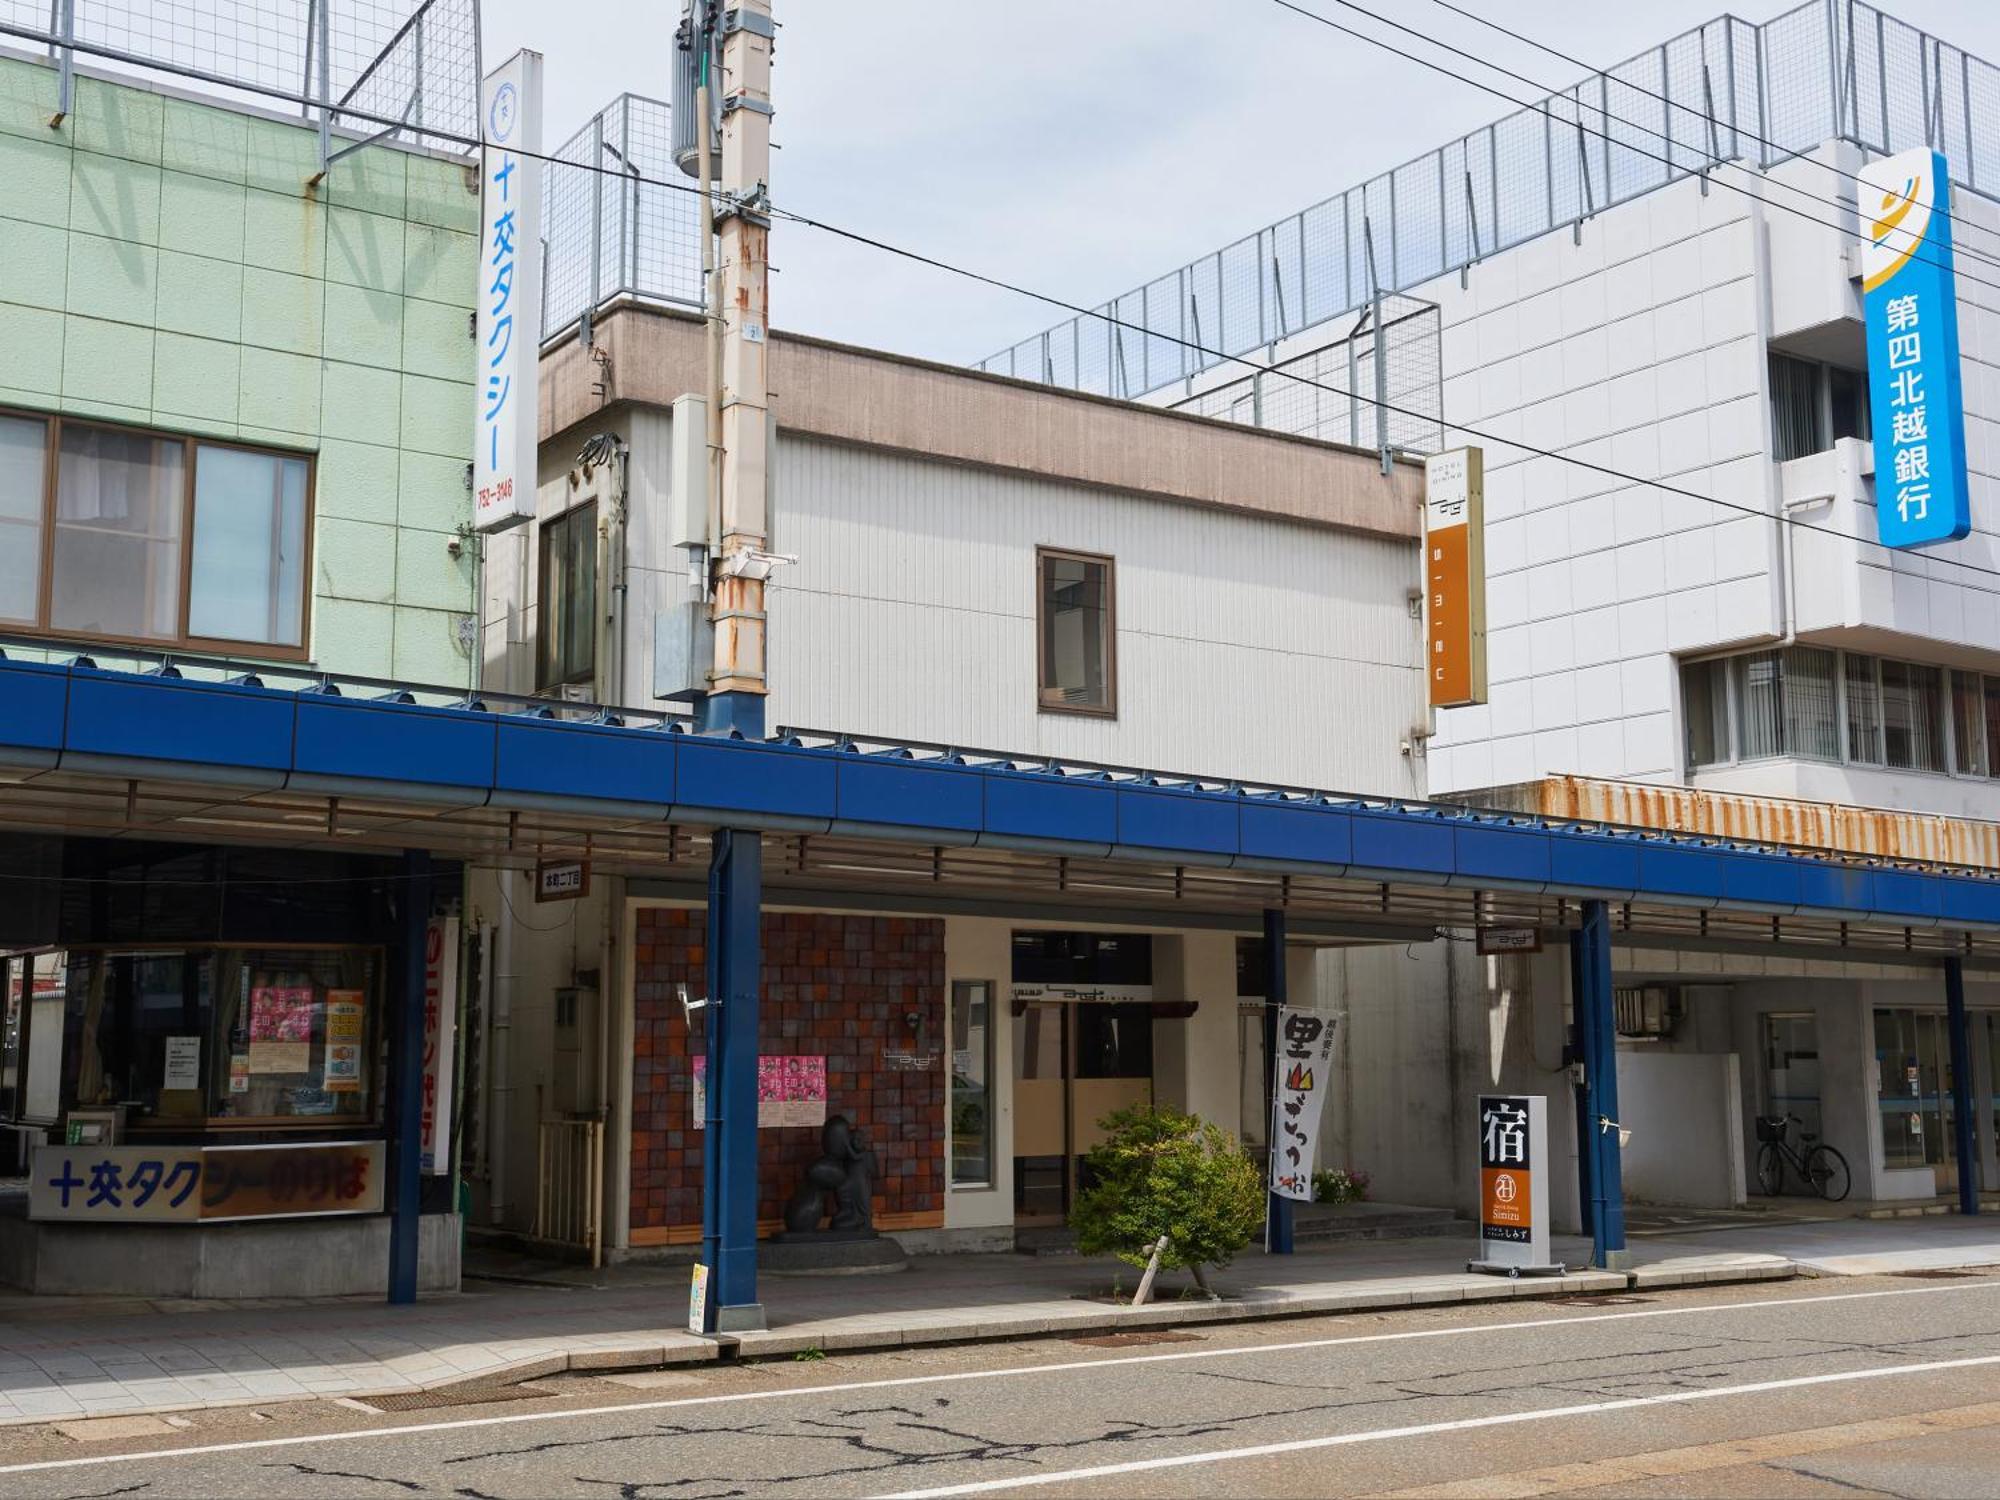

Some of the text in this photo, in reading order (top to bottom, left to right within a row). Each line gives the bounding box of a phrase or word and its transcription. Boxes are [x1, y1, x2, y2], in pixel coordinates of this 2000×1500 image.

[486, 152, 515, 471] 十交タクシー
[1886, 294, 1931, 523] 第四北越銀行
[546, 870, 580, 888] 本町二丁目
[1483, 1103, 1527, 1162] 宿
[1492, 1208, 1519, 1221] Simizu
